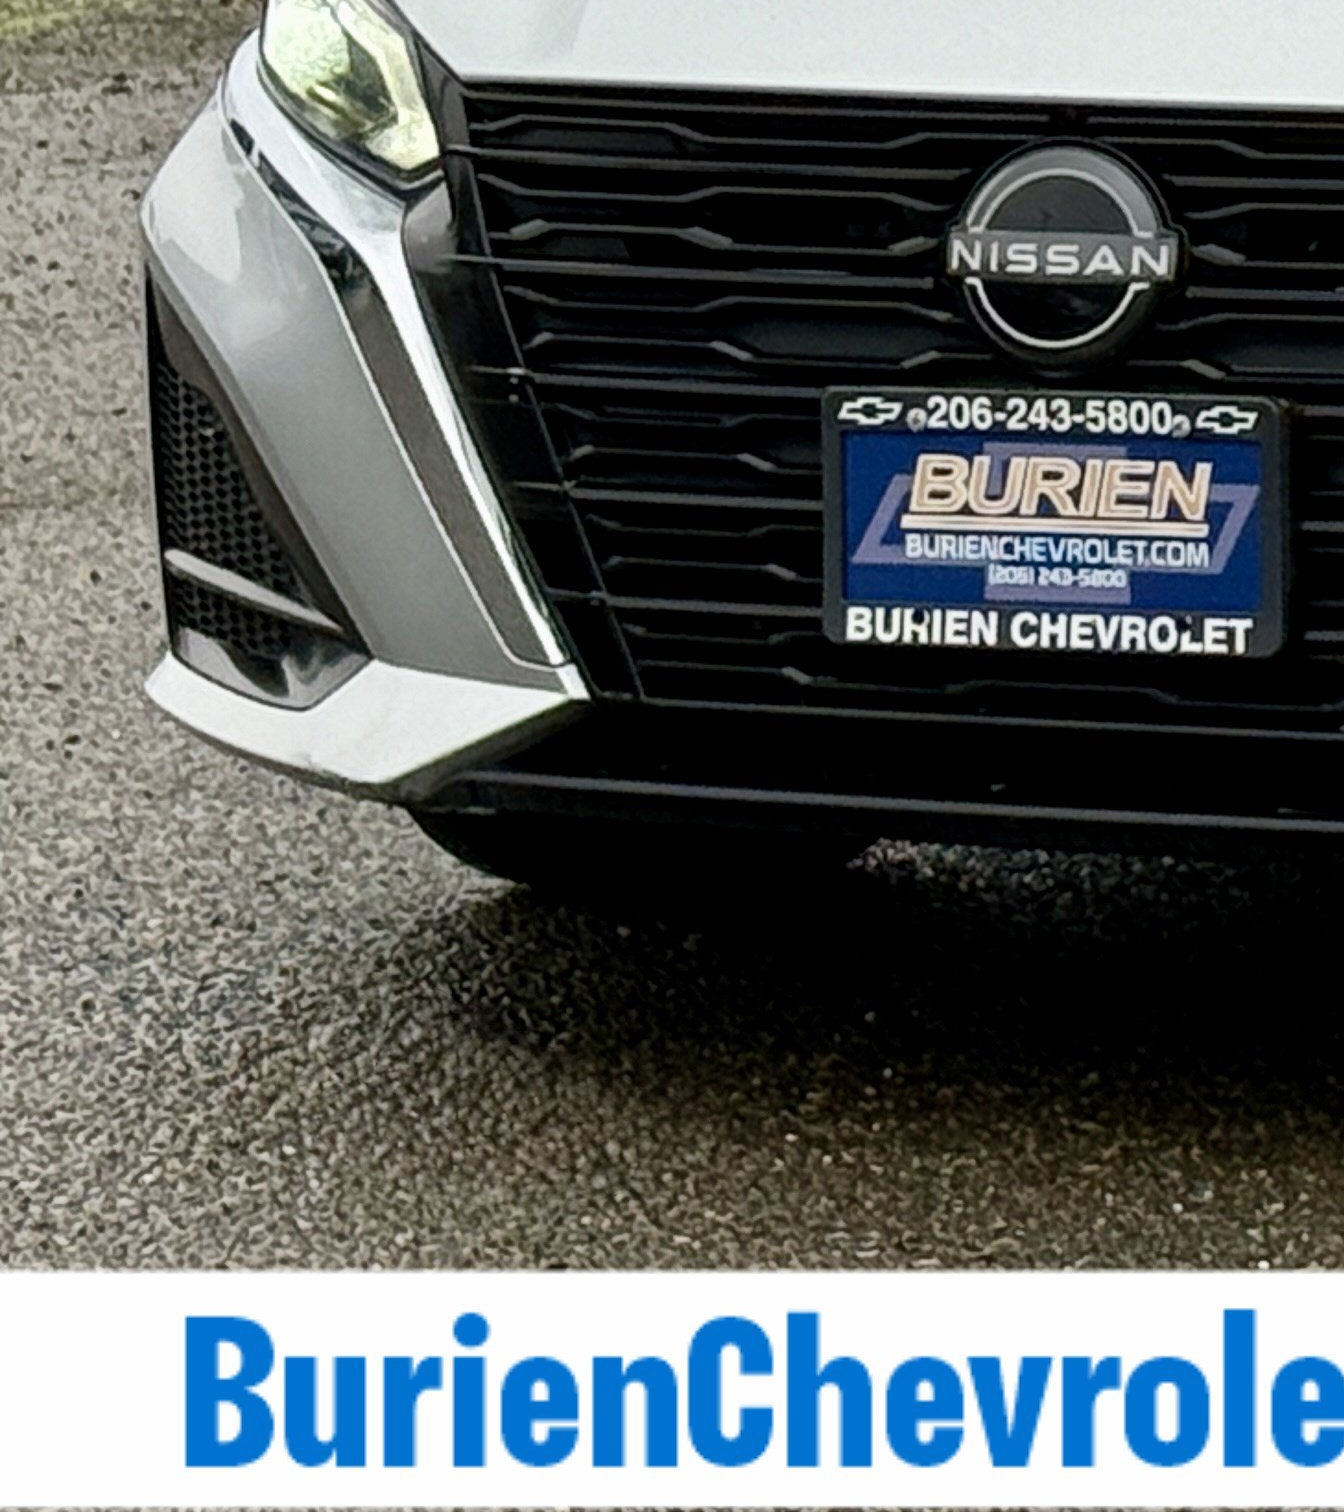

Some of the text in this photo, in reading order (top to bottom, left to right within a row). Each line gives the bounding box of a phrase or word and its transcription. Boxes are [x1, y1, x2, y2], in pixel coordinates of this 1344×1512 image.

[950, 239, 1170, 276] NISSAN
[926, 396, 1173, 435] 206-243-5800
[908, 452, 1214, 521] BURIEN
[904, 533, 1210, 569] BURIENCHEVROLET.COM
[845, 606, 1254, 656] BURIEN CHEVROLET
